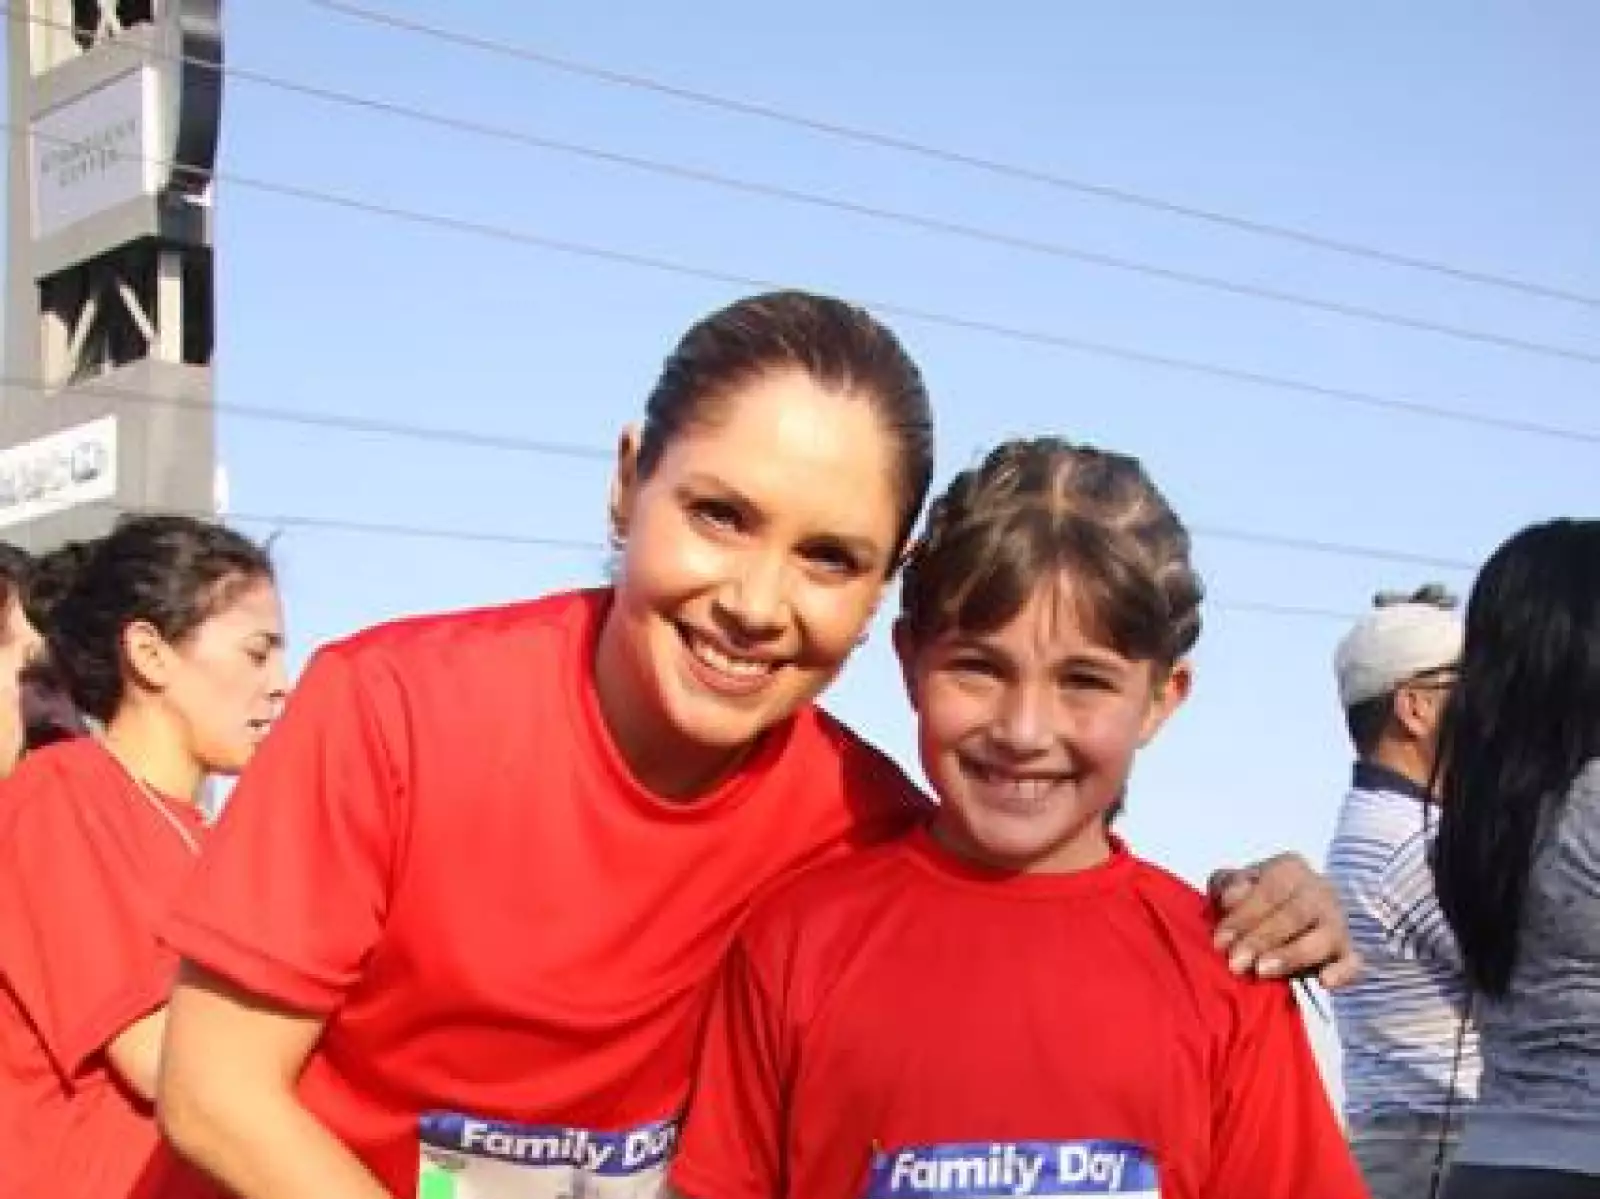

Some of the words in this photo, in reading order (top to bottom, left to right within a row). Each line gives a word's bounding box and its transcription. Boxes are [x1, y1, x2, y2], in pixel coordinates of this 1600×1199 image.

[461, 1120, 614, 1169] Family
[891, 1143, 1042, 1195] Family
[1059, 1146, 1126, 1193] Day
